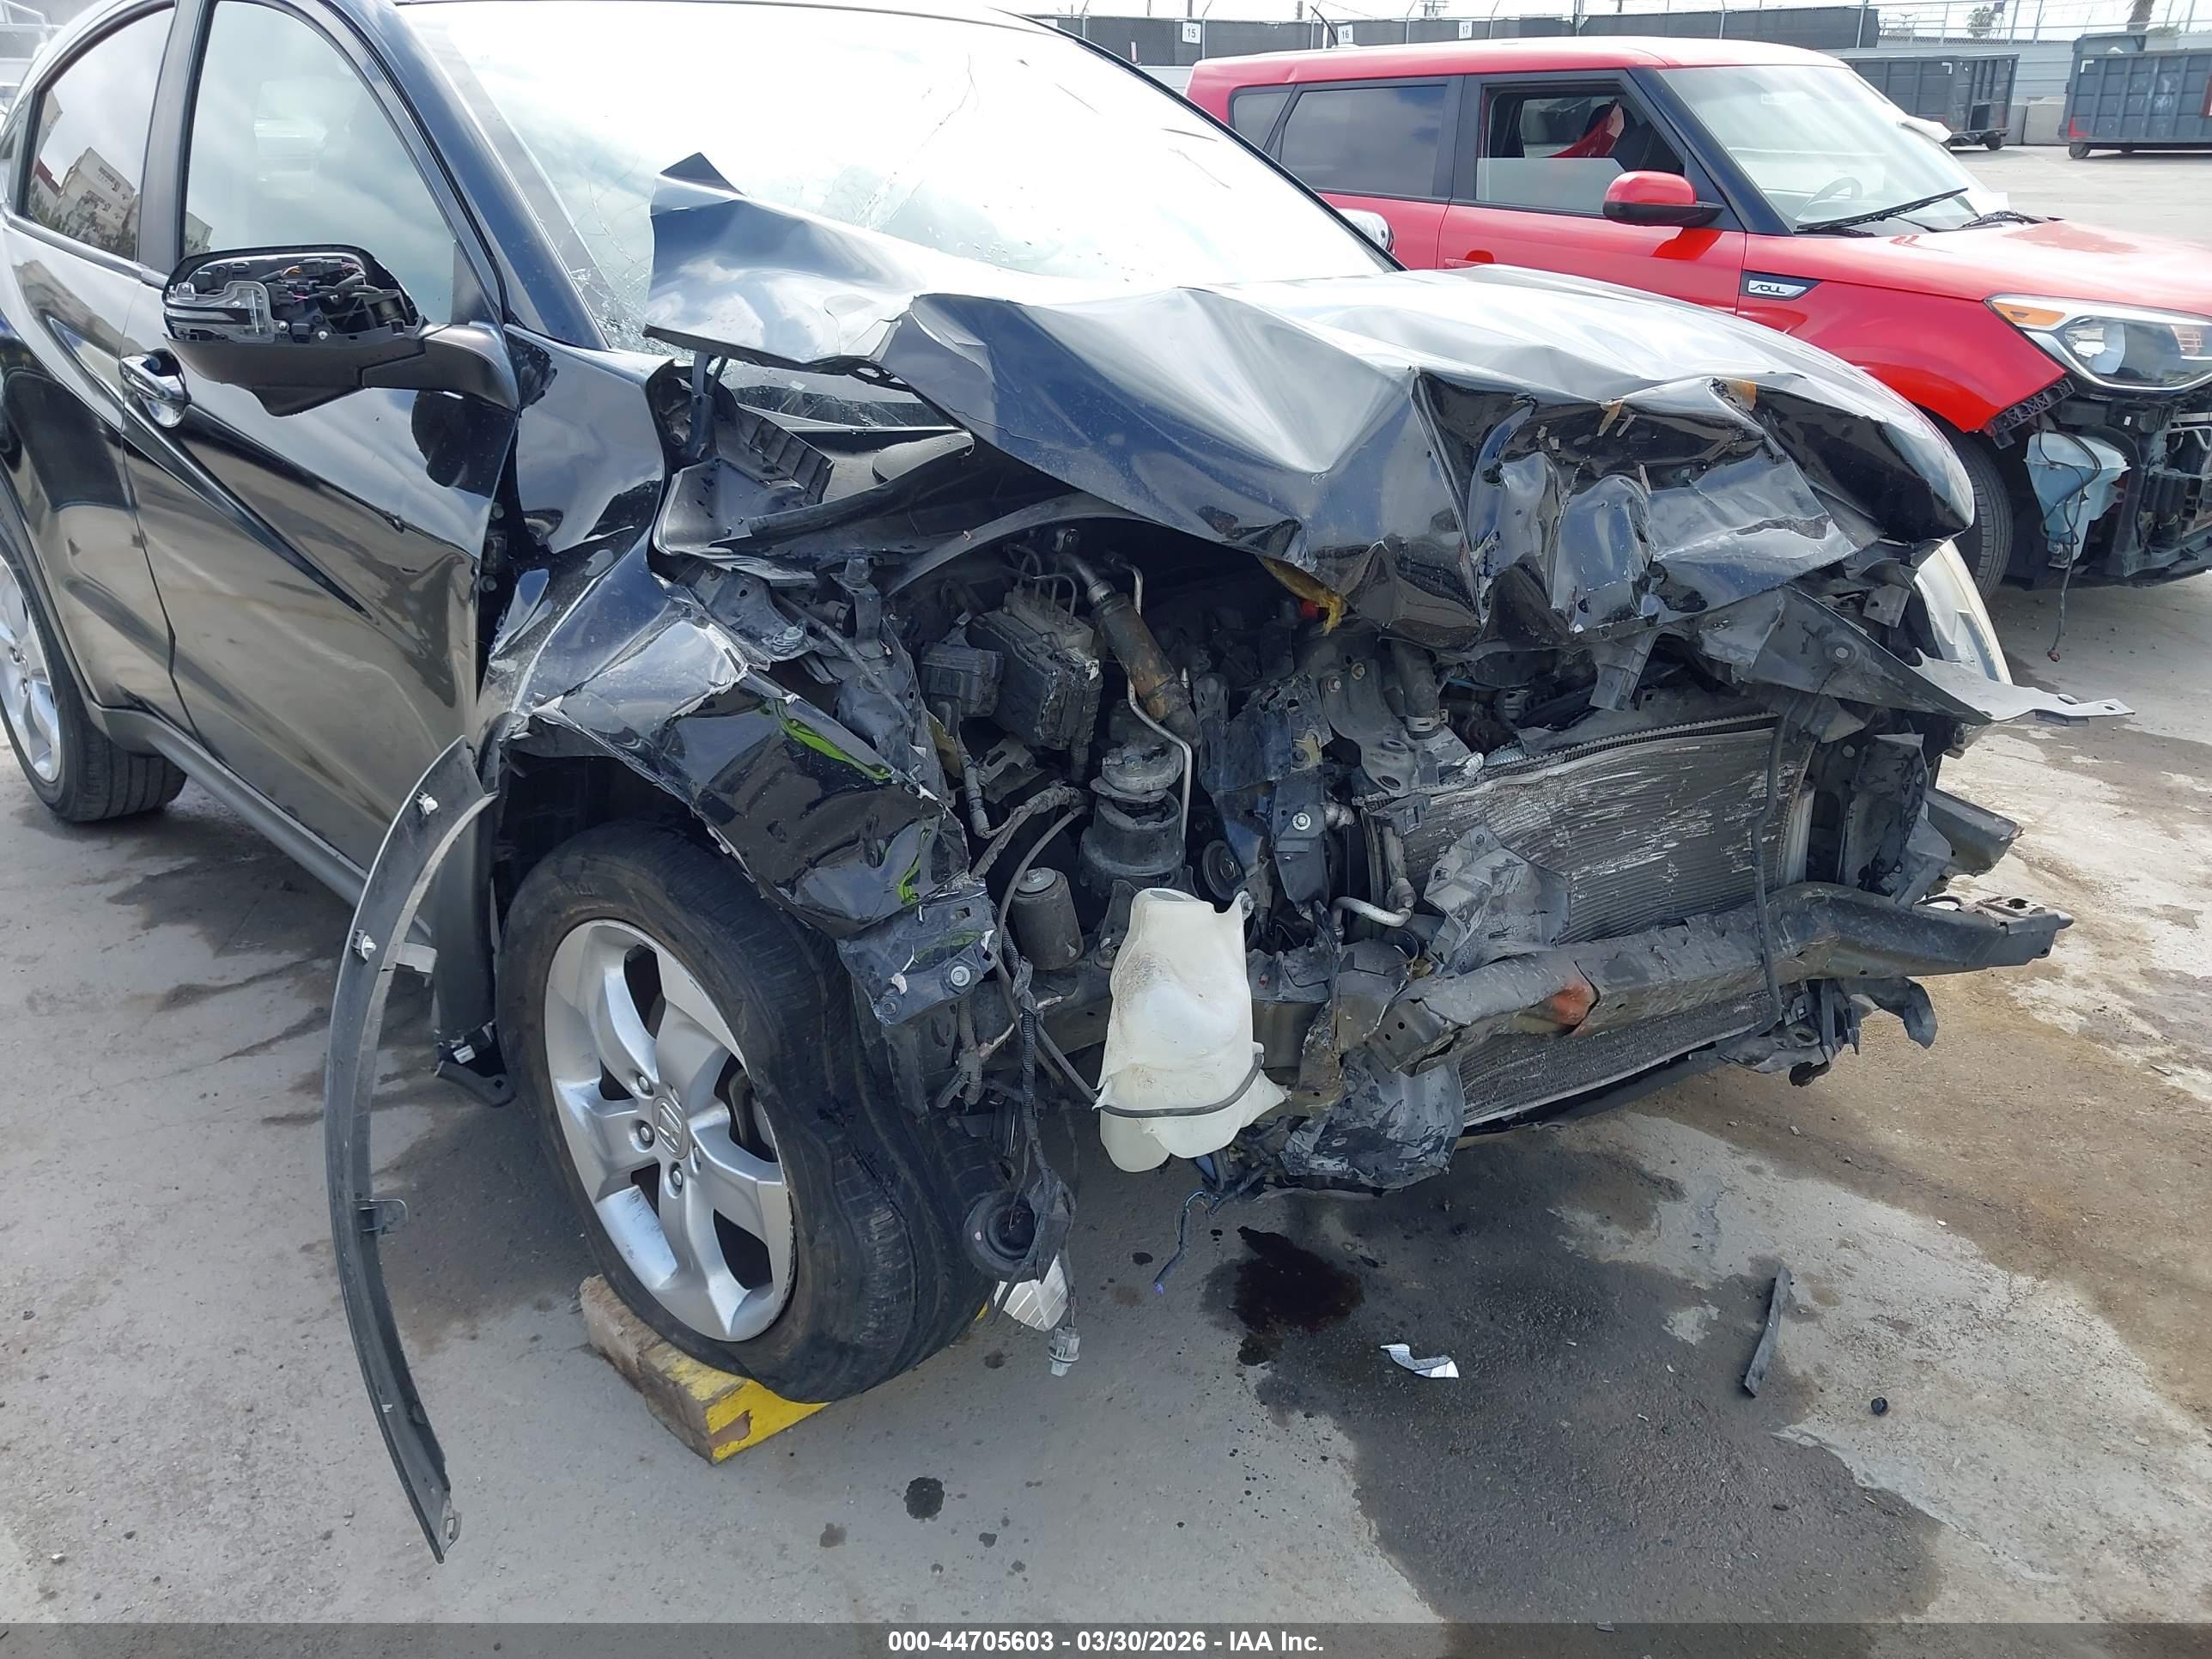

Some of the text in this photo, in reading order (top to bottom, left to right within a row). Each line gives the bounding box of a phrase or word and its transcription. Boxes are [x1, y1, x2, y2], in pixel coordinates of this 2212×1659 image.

[1187, 27, 1196, 39] 15
[1341, 29, 1350, 40] 16
[1462, 25, 1469, 35] 17
